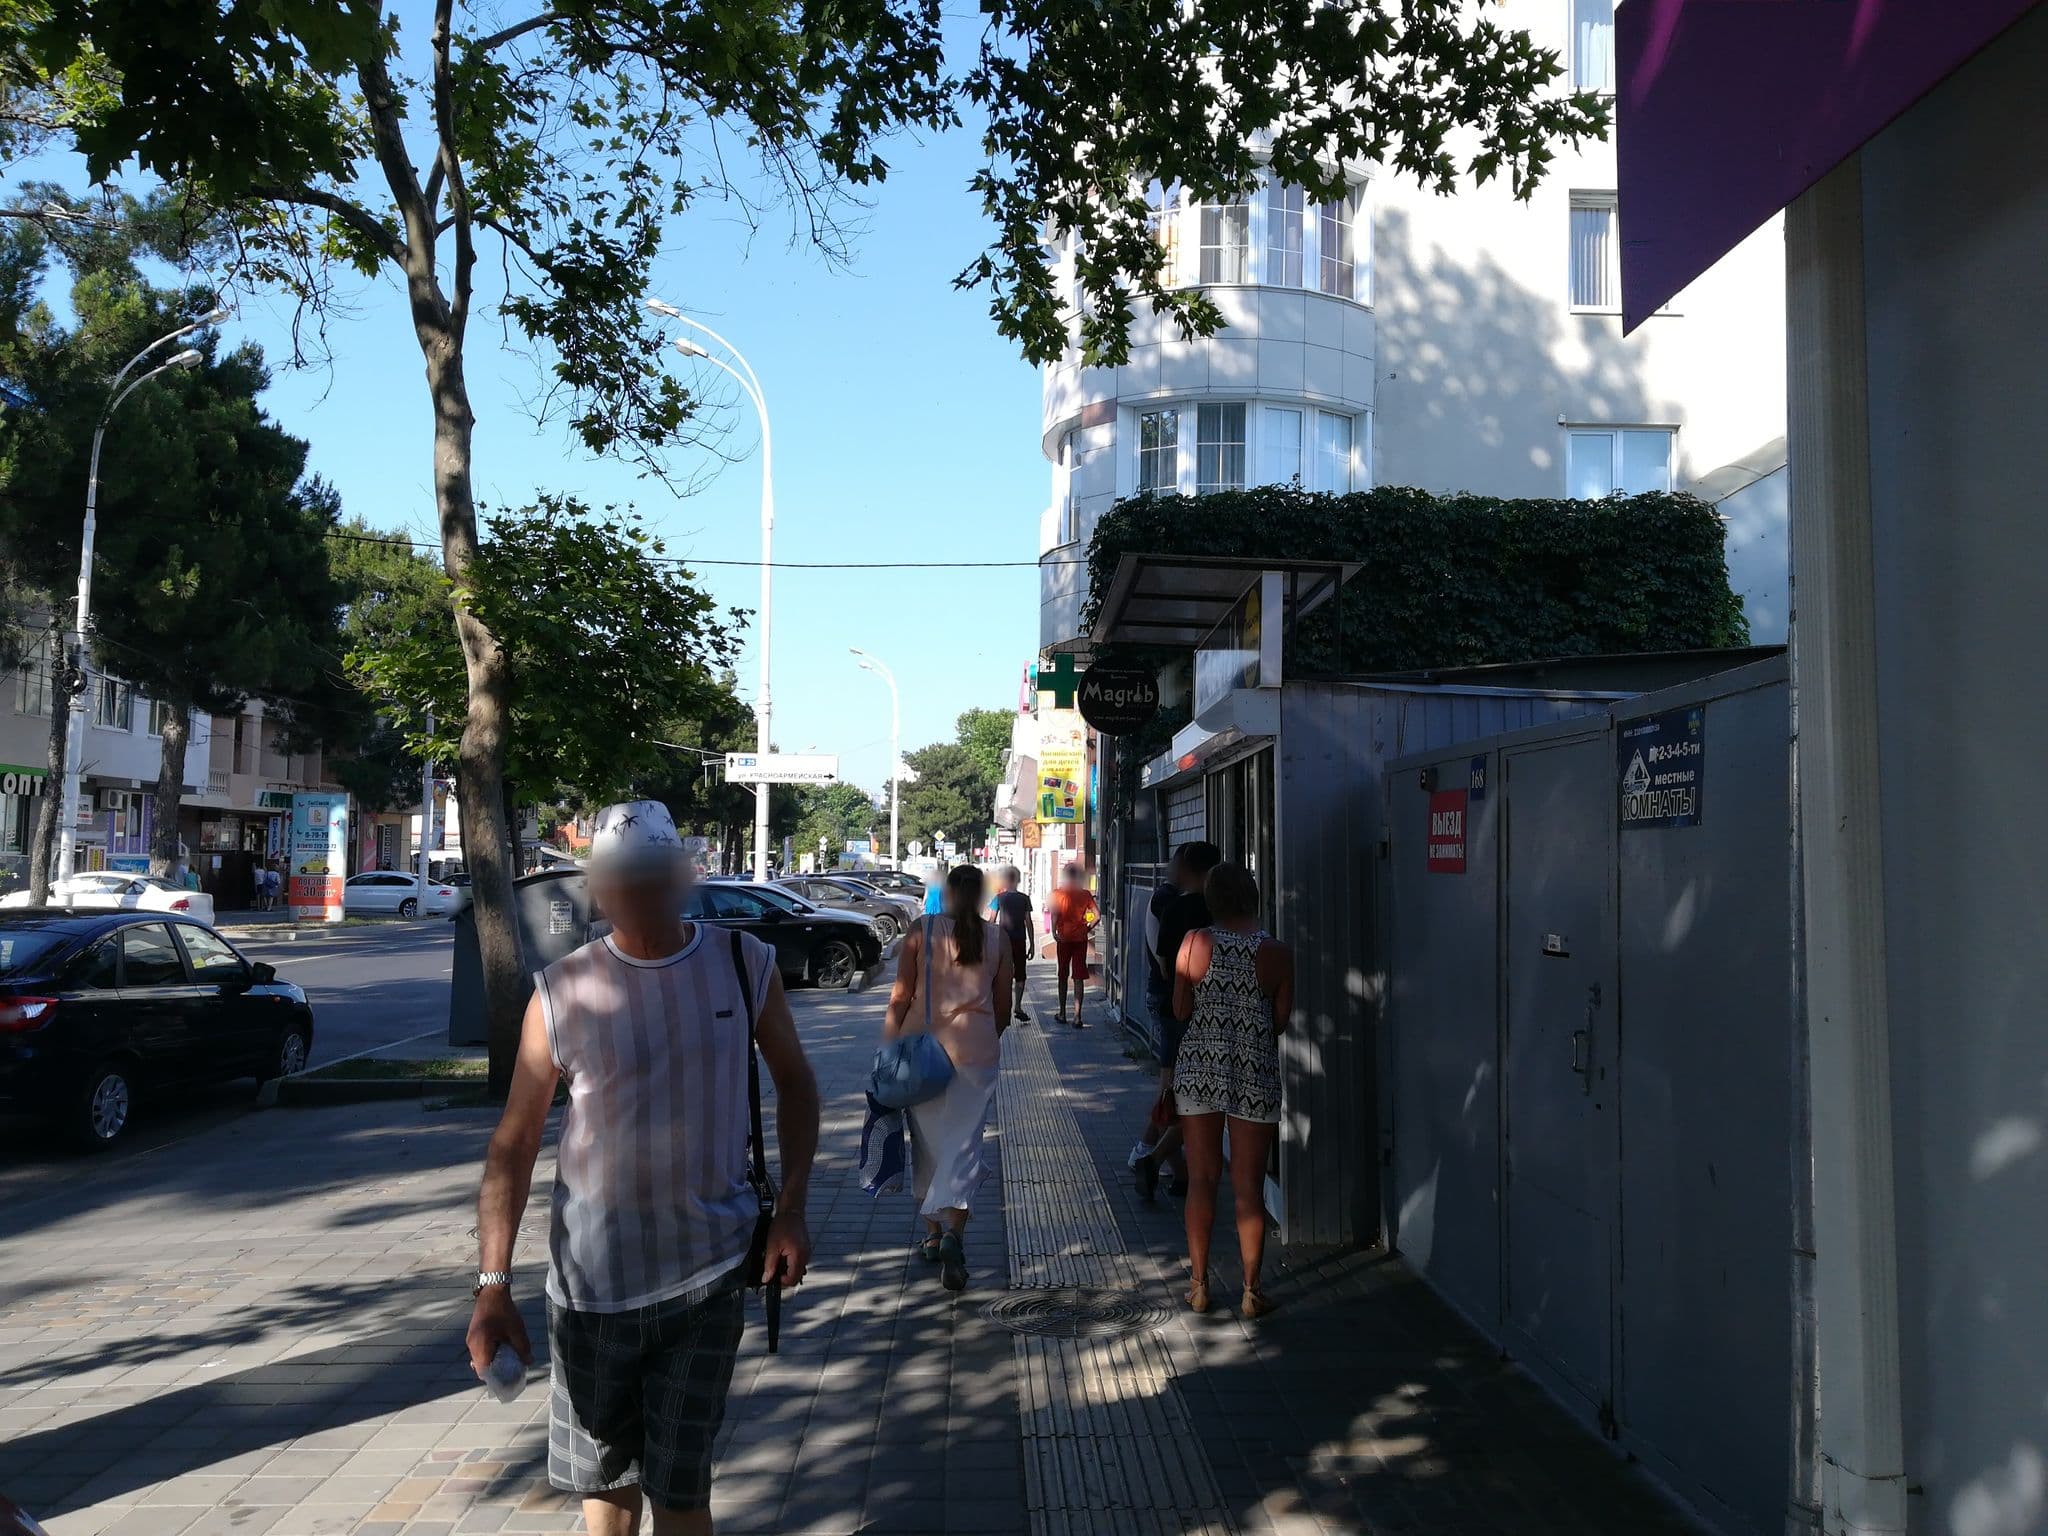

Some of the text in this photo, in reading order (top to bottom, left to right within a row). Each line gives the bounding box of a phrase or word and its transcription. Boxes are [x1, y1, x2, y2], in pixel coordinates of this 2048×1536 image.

[1082, 681, 1154, 708] Magrib
[1655, 770, 1695, 785] местные
[1622, 787, 1696, 821] КОМНАТЫ
[1432, 810, 1462, 838] ВЫЕЗД
[303, 886, 316, 897] 30
